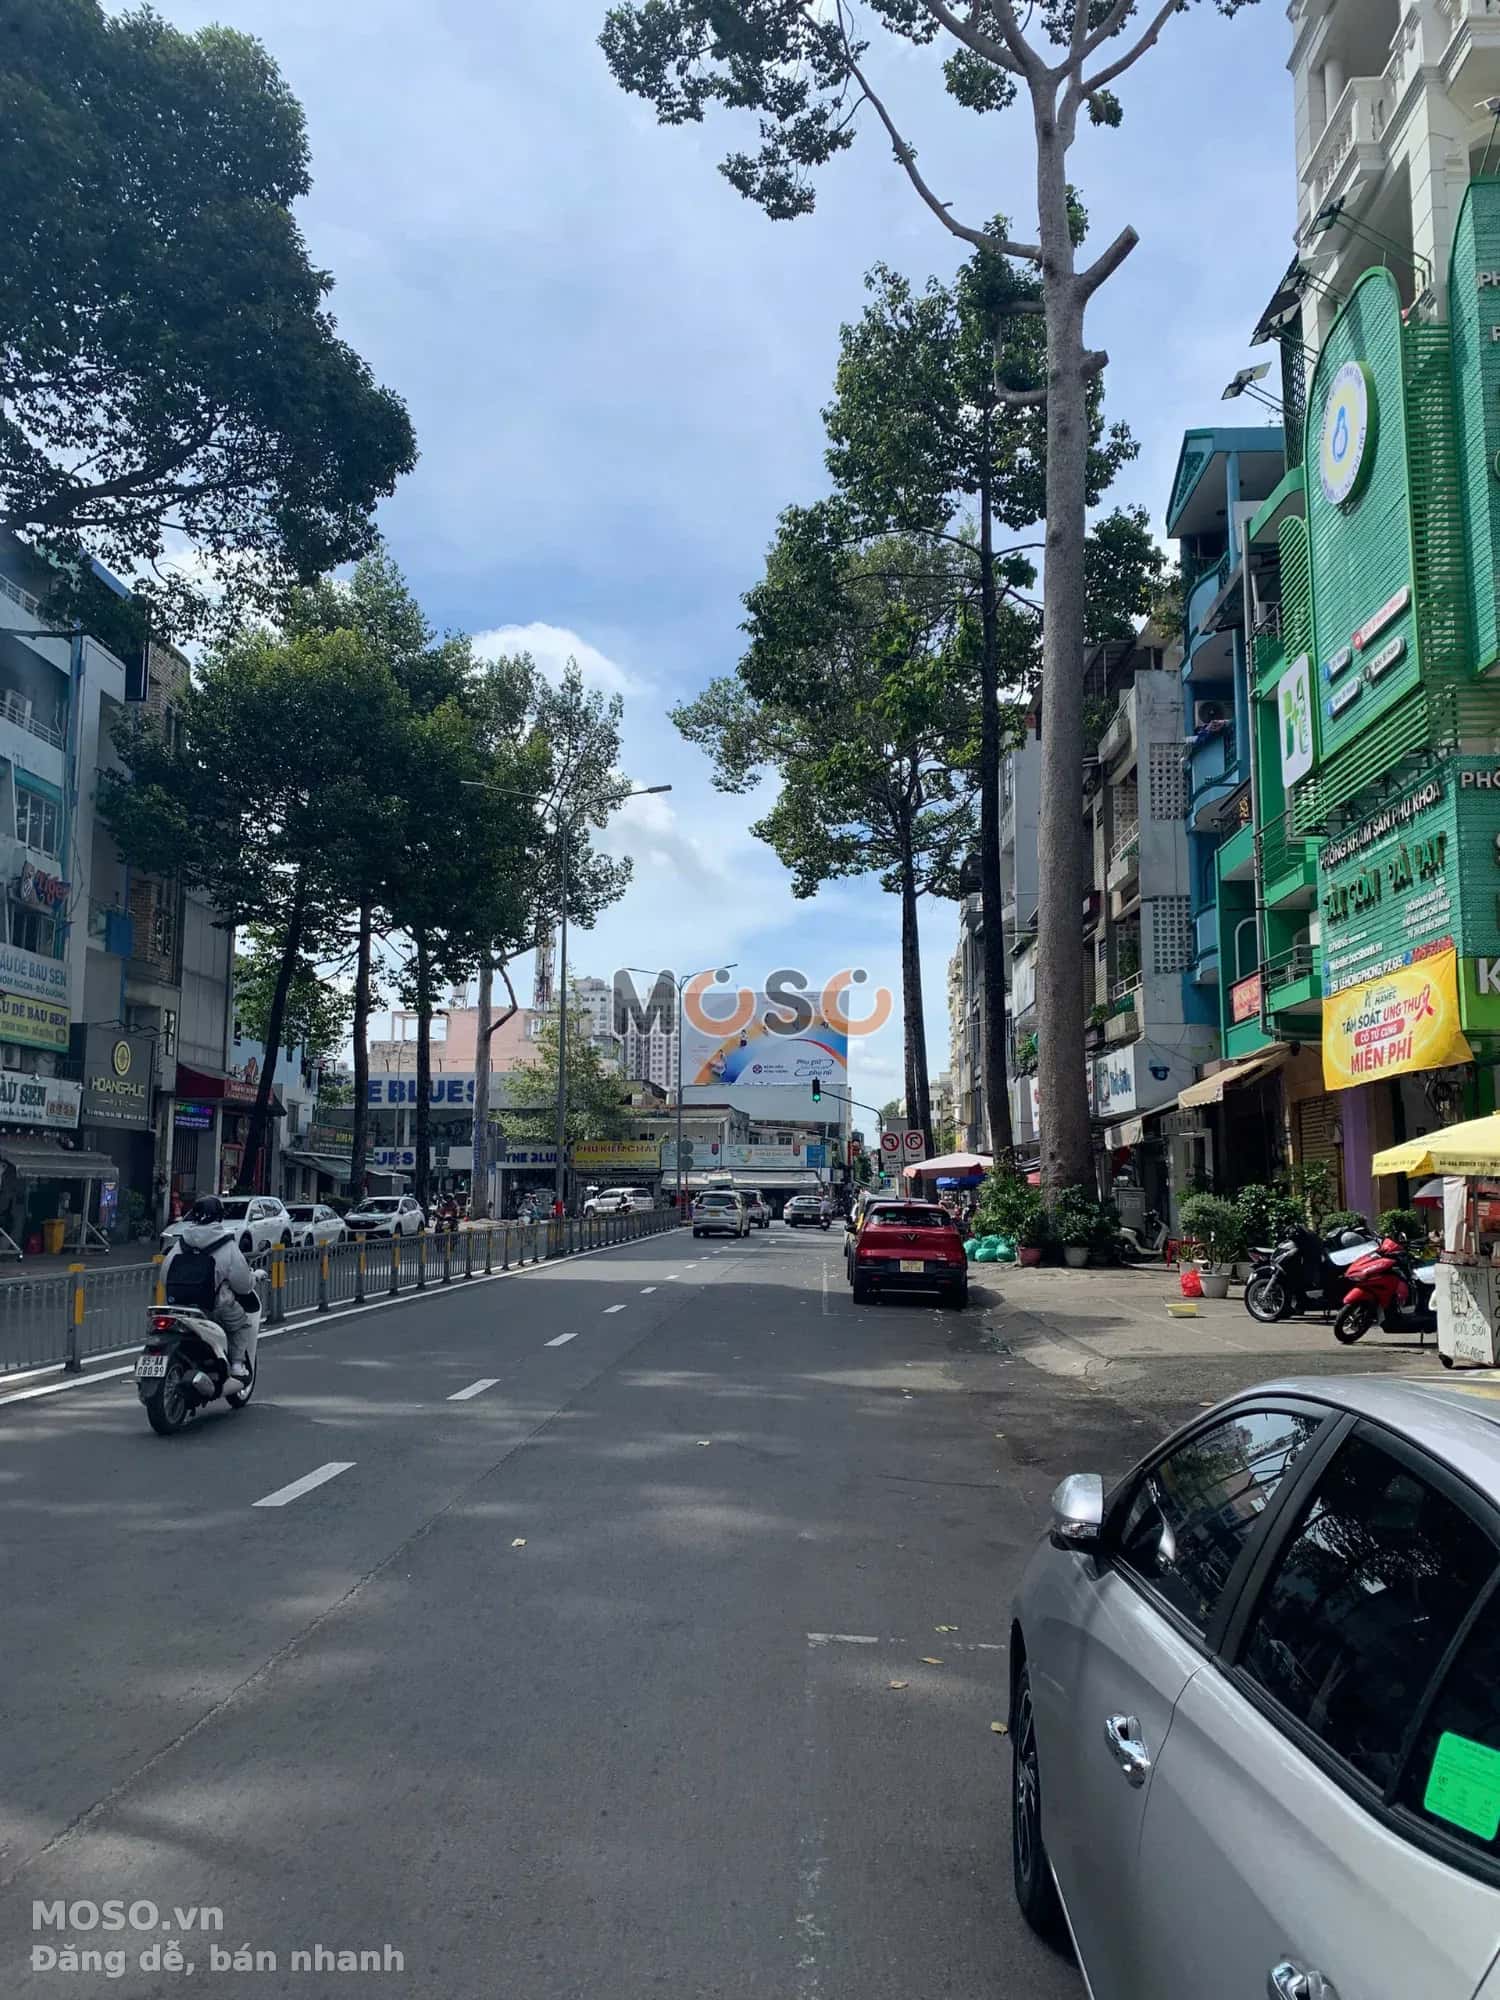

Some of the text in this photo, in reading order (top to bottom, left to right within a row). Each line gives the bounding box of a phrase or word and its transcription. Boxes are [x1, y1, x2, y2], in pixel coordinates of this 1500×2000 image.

[1413, 782, 1440, 811] KHOA
[34, 869, 71, 904] Tiger
[1358, 1008, 1381, 1029] SOÁT
[1351, 1031, 1413, 1075] MIỄN PHÍ
[20, 1084, 47, 1107] SEN
